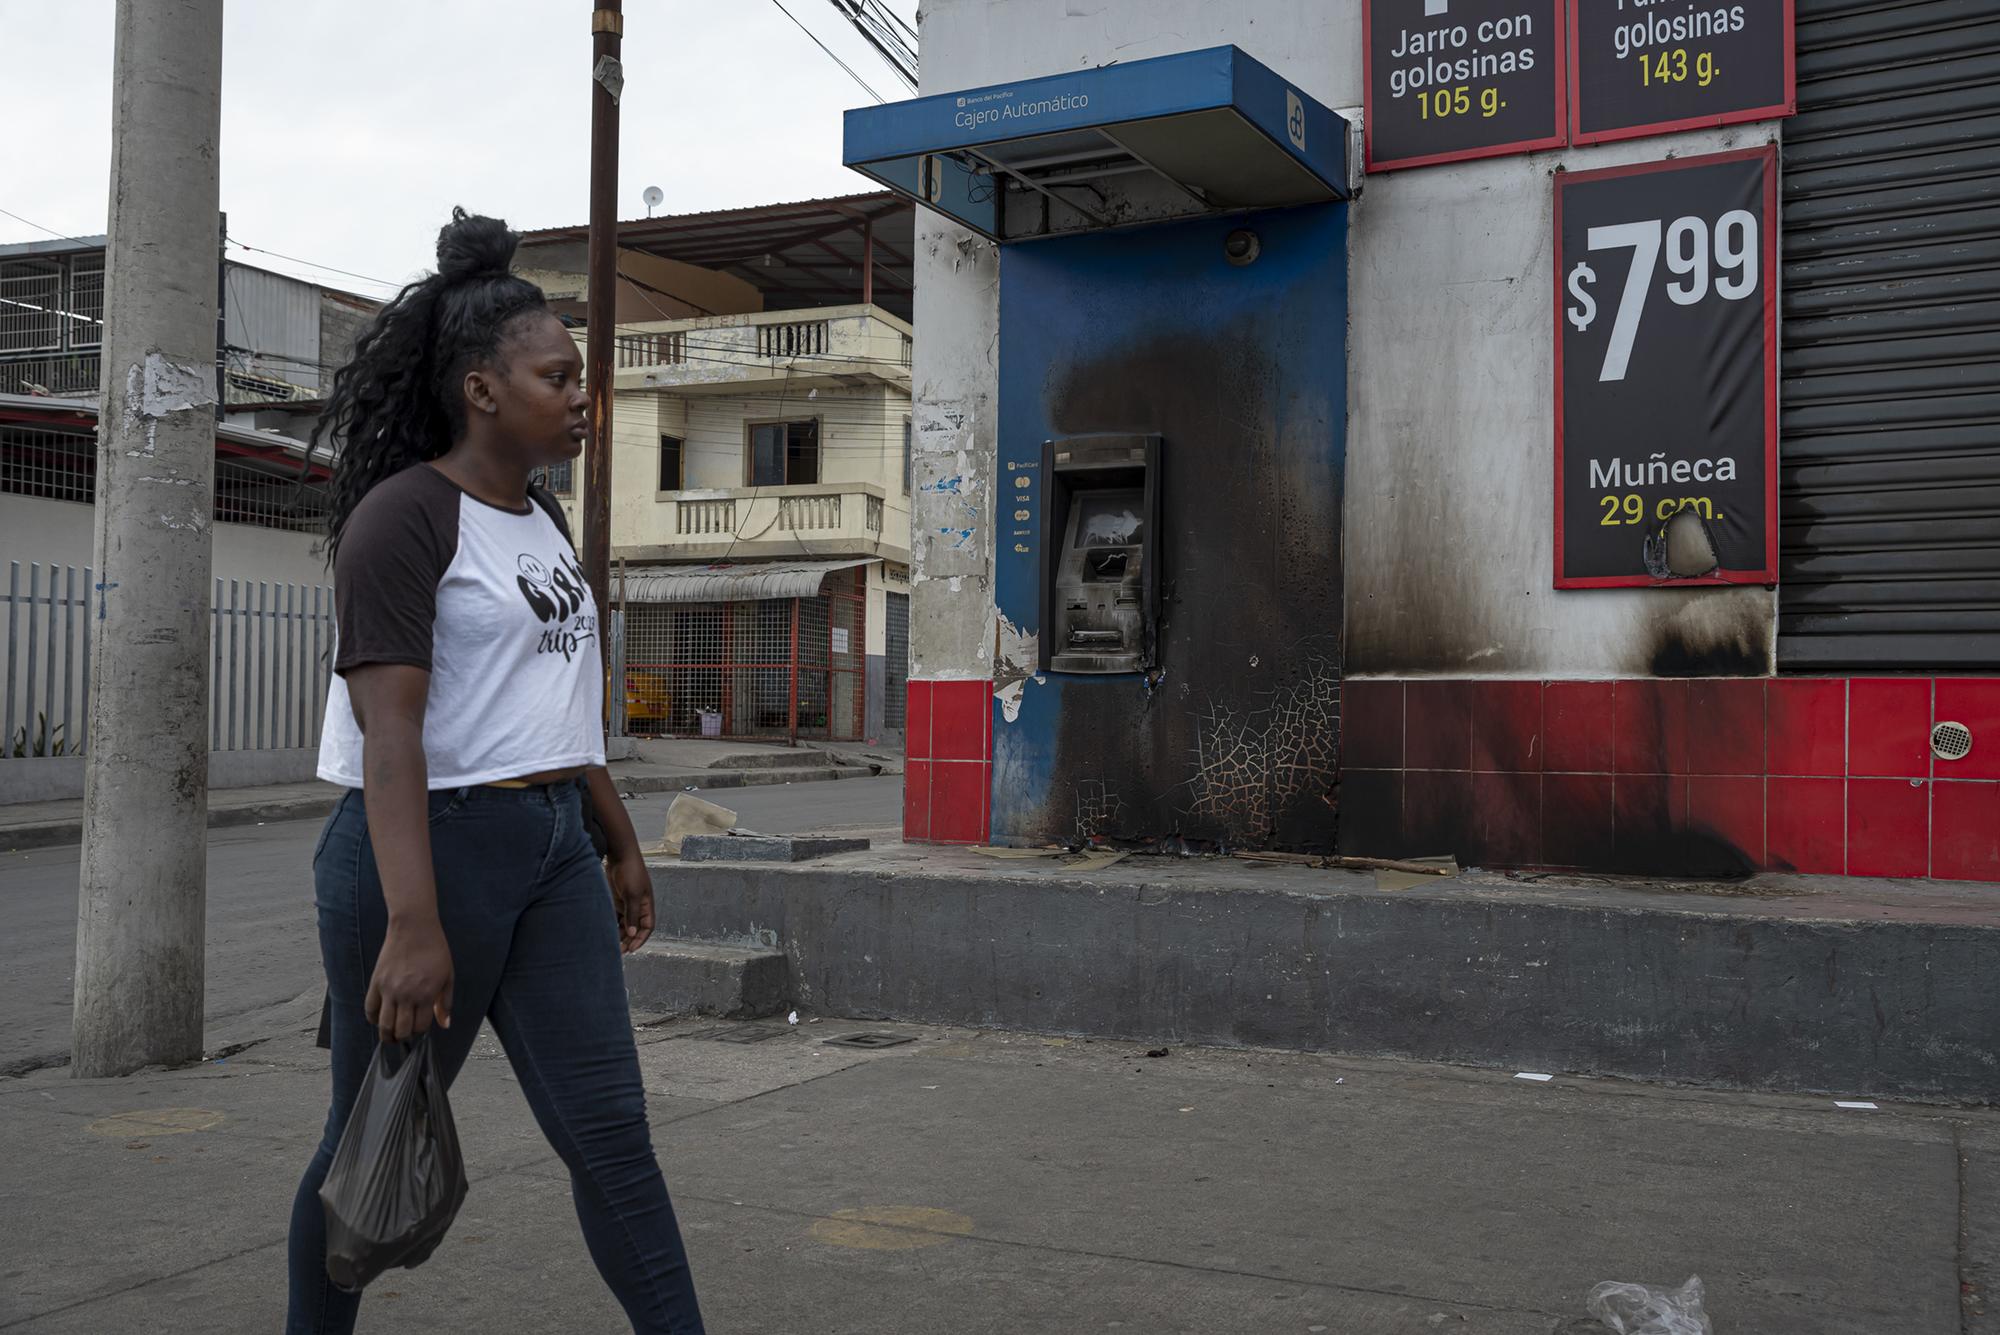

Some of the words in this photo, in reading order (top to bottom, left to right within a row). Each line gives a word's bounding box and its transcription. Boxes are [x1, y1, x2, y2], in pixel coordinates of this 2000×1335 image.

[1391, 26, 1468, 58] Jarro
[1477, 14, 1532, 43] con
[1614, 5, 1745, 60] golosinas
[1390, 48, 1535, 98] golosinas
[1639, 48, 1688, 87] 143
[1696, 52, 1720, 87] g.
[955, 109, 999, 130] Cajero
[1002, 93, 1089, 119] Automático
[1417, 85, 1470, 120] 105
[1480, 87, 1506, 118] g.
[1589, 452, 1736, 489] Muñeca
[1600, 494, 1643, 526] 29
[1656, 496, 1724, 520] cm.
[537, 627, 595, 663] trip
